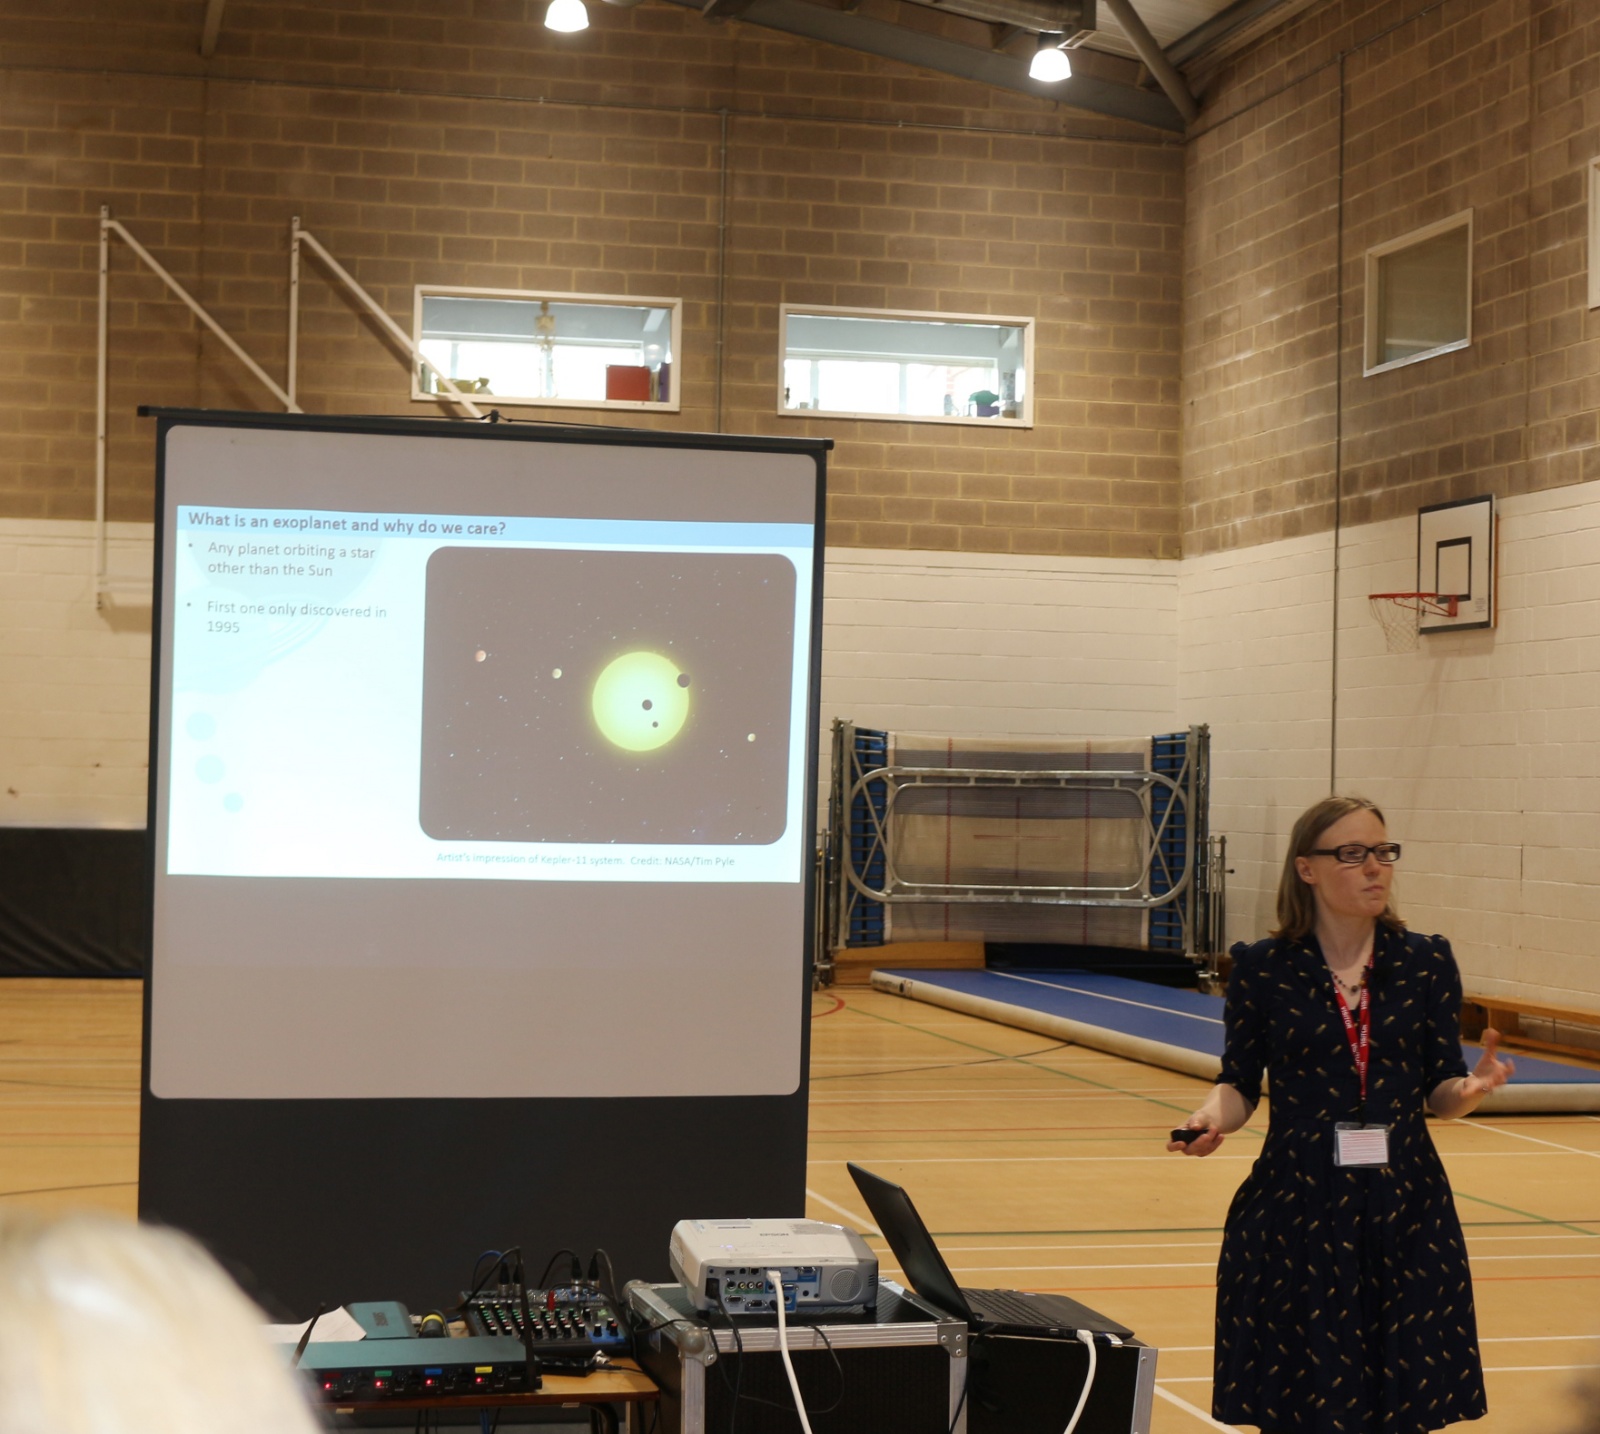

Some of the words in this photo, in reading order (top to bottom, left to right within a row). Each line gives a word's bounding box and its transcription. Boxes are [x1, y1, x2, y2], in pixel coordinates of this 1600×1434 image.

[188, 511, 230, 527] What
[234, 514, 247, 527] is
[250, 517, 268, 528] an
[273, 515, 347, 531] exoplanet
[351, 518, 379, 532] and
[383, 519, 414, 535] why
[418, 519, 437, 533] do
[441, 523, 462, 534] we
[467, 521, 506, 535] care?
[208, 541, 234, 556] Any
[238, 543, 280, 557] planet
[283, 544, 335, 560] orbiting
[339, 548, 347, 558] a
[350, 547, 375, 559] star
[208, 562, 245, 574] other
[249, 563, 279, 576] than
[283, 564, 305, 576] the
[308, 564, 333, 577] Sun
[207, 601, 236, 613] First
[240, 604, 265, 615] one
[268, 602, 297, 617] only
[300, 603, 371, 618] discovered
[375, 605, 387, 618] in
[207, 620, 240, 633] 1995
[437, 852, 470, 862] Artist's
[473, 854, 526, 864] impression
[528, 854, 539, 864] of
[541, 855, 587, 865] Kepler-11
[590, 856, 625, 867] system.
[630, 856, 662, 866] Credit:
[665, 856, 713, 867] NASA/Tim
[715, 856, 735, 868] Pyle
[1341, 1006, 1353, 1029] VISITOR
